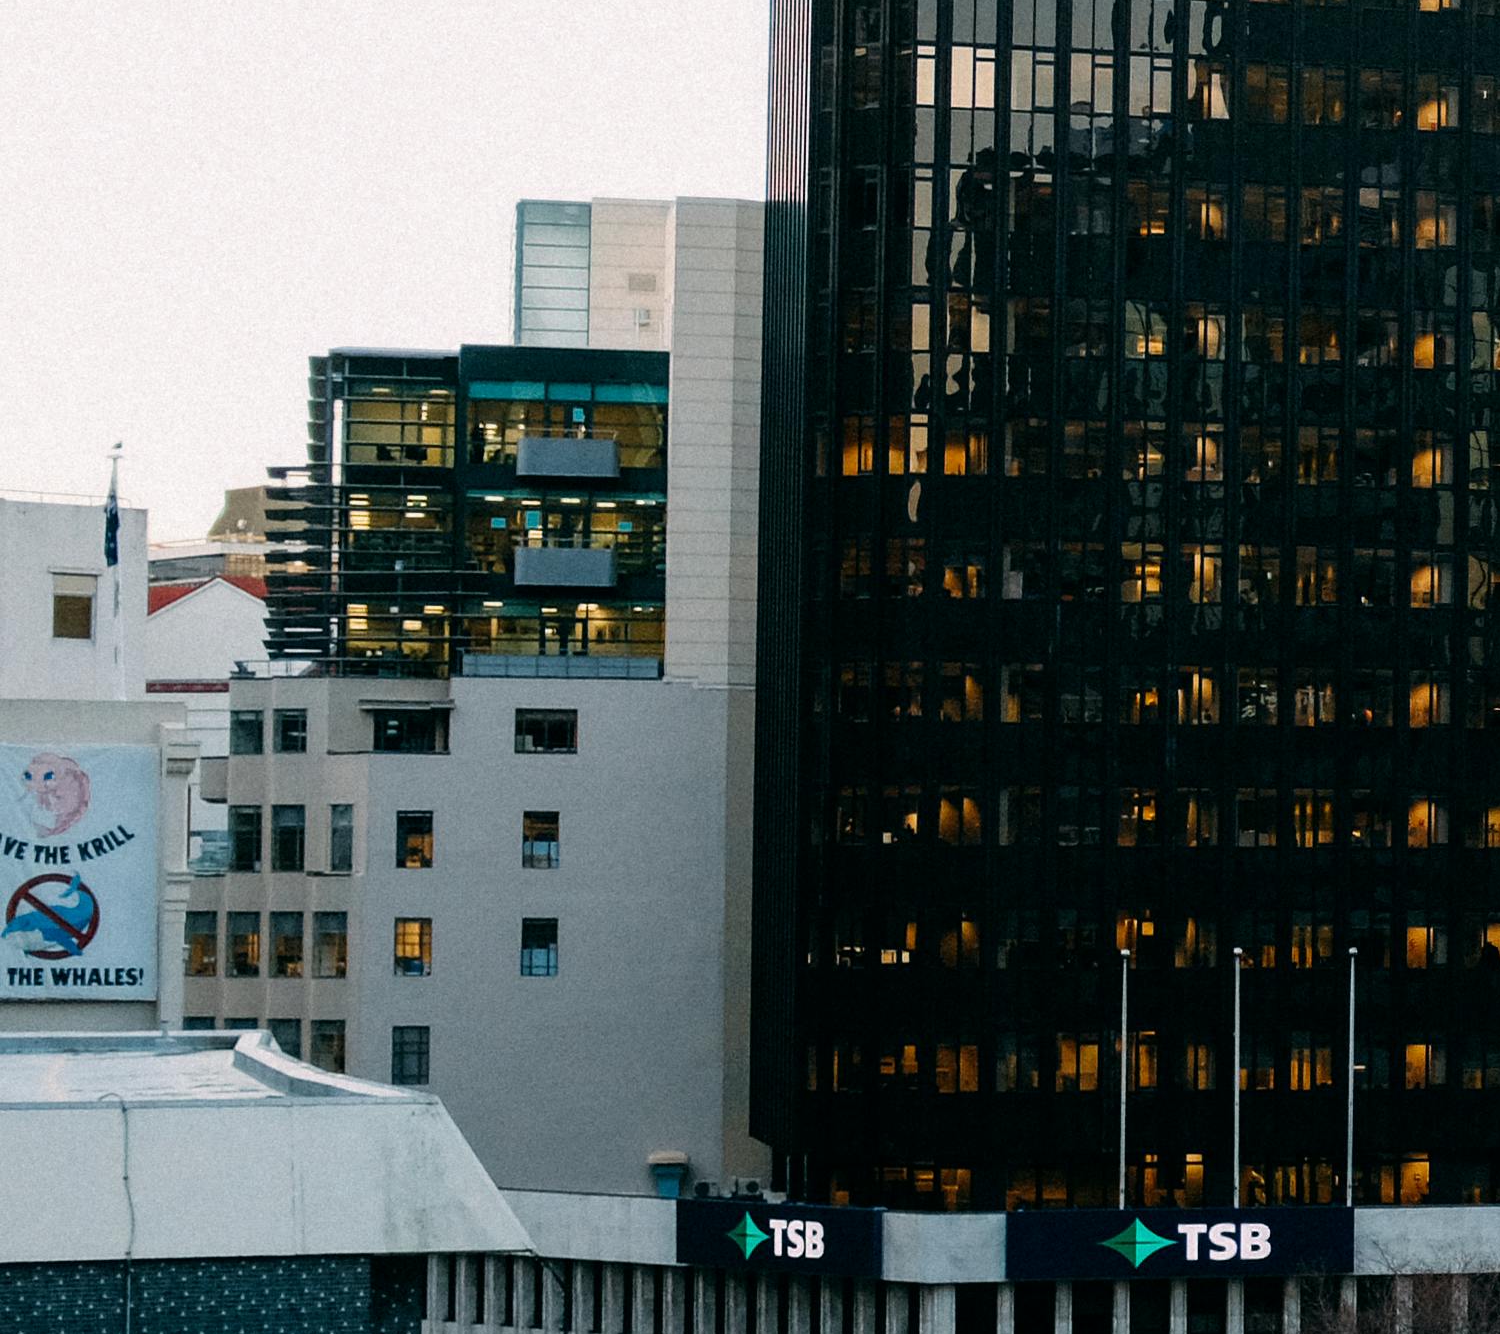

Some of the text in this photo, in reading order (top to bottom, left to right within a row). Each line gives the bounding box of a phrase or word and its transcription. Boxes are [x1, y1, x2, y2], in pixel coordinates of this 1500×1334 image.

[33, 844, 72, 865] THE
[77, 824, 136, 862] KRILL
[7, 967, 144, 987] THE WHALES!
[769, 1218, 826, 1259] TSB
[1178, 1222, 1272, 1261] TSB
